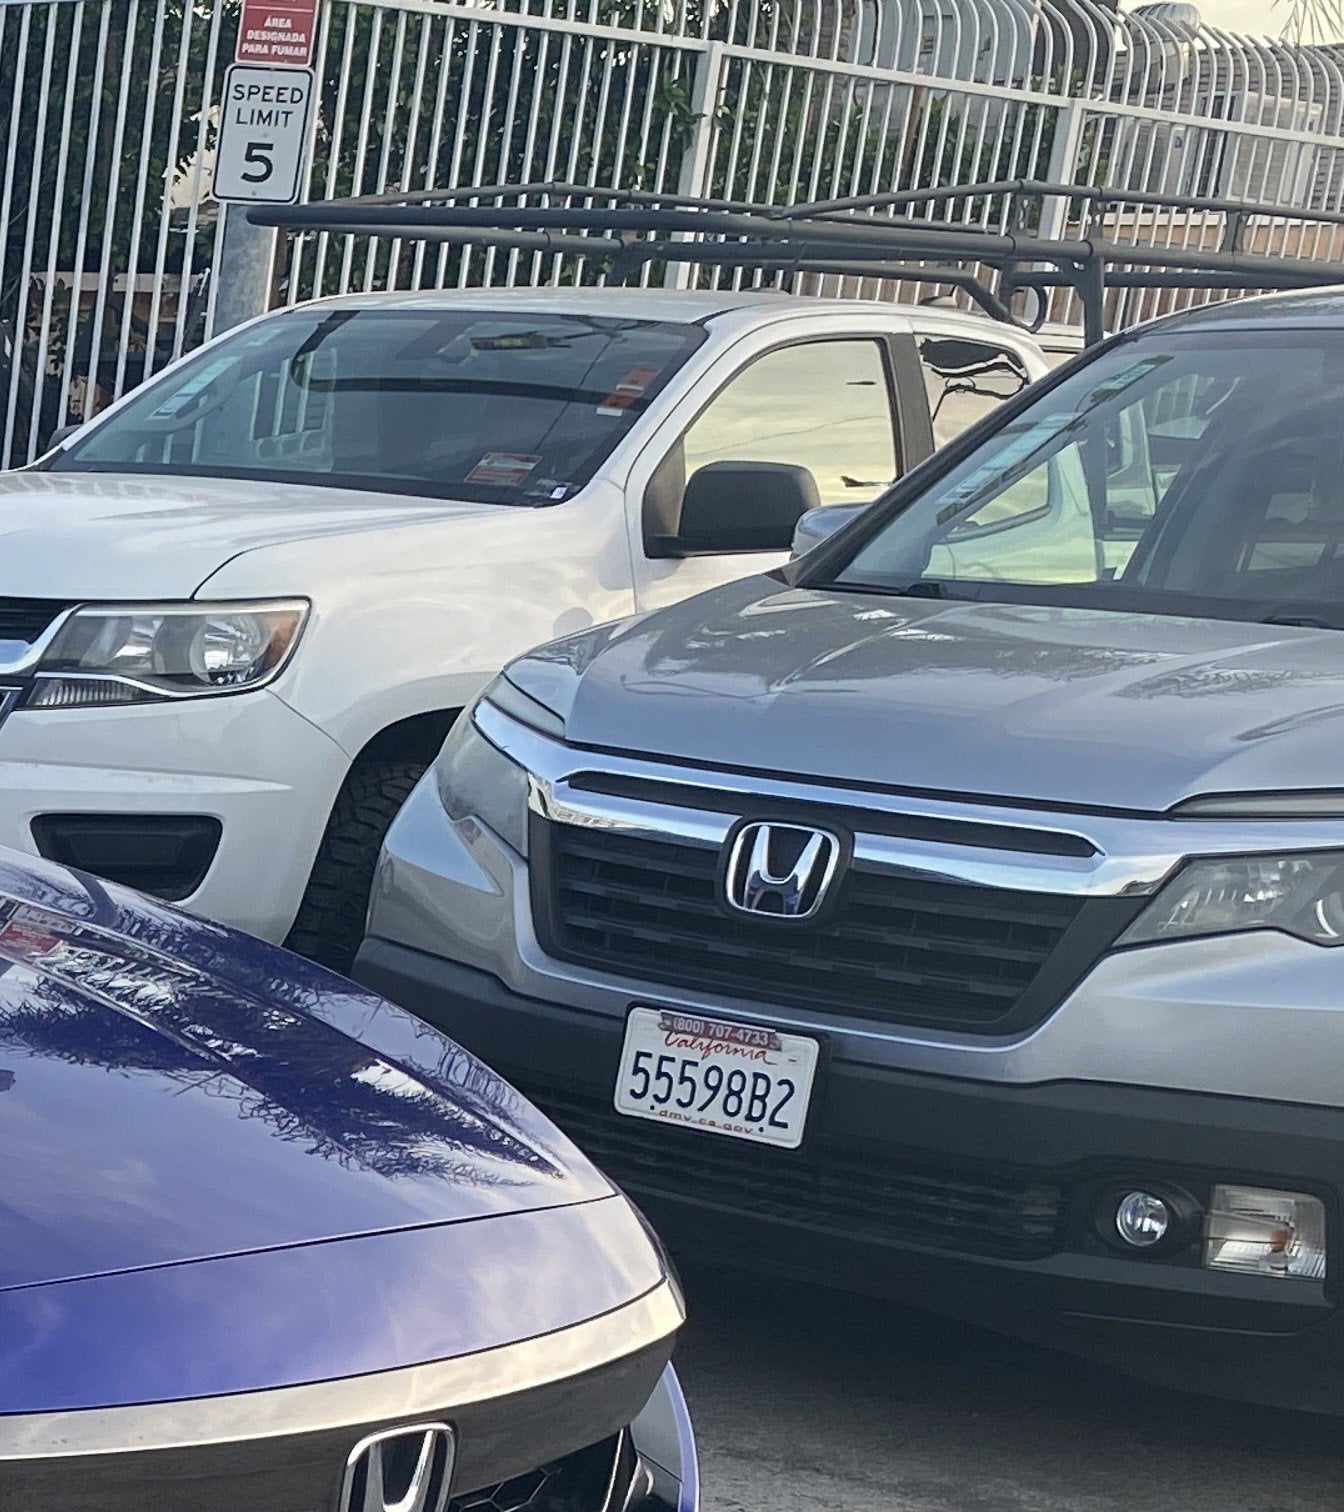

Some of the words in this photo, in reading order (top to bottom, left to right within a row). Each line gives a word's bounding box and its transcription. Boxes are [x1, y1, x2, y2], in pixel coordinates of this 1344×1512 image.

[246, 29, 306, 43] DESIGNADA
[241, 42, 269, 55] PARA
[271, 44, 308, 57] FUMAR
[232, 84, 304, 105] SPEED
[236, 108, 294, 128] LIMIT
[240, 142, 274, 184] 5
[672, 1018, 705, 1034] (800)
[709, 1022, 769, 1045] 707-4733
[664, 1031, 778, 1066] California
[629, 1050, 796, 1129] 55598B2
